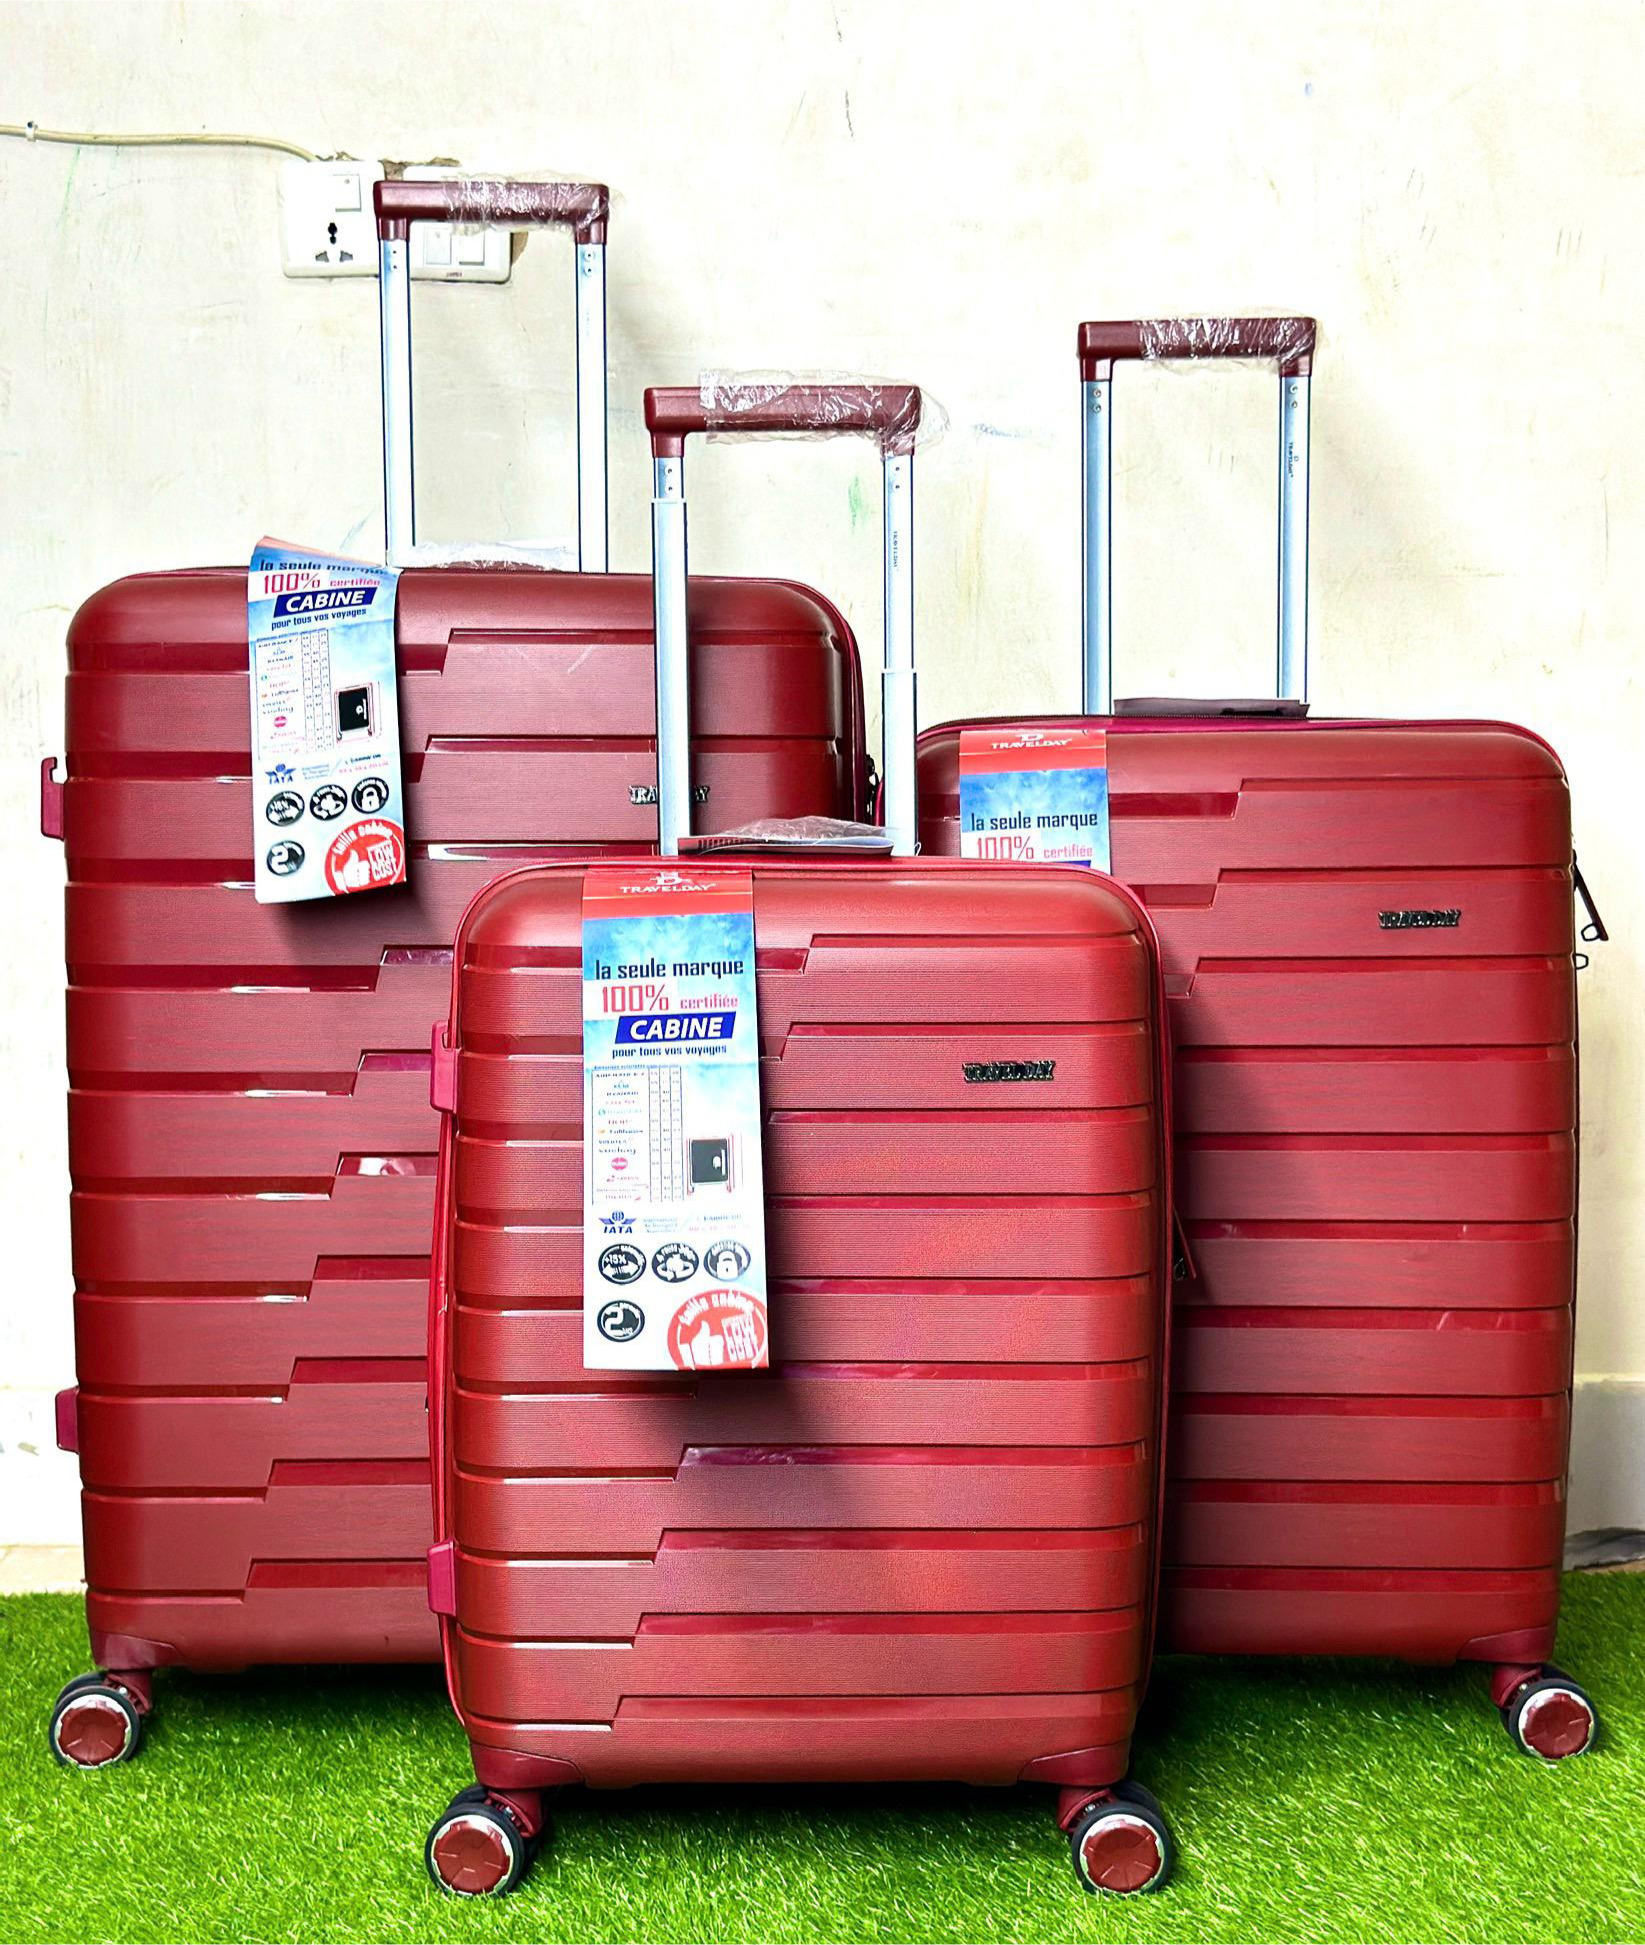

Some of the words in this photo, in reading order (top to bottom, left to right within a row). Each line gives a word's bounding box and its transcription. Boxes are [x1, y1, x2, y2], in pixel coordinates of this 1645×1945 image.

[260, 559, 273, 571] la
[279, 561, 321, 570] seule
[263, 573, 320, 594] 100%
[286, 591, 365, 613] CABINE
[271, 619, 291, 631] pour
[293, 615, 311, 626] tous
[314, 613, 328, 621] vos
[332, 608, 366, 619] voyages
[991, 738, 1072, 749] TRAVELDAY
[269, 775, 293, 784] IATA
[971, 812, 984, 831] la
[990, 811, 1031, 830] seule
[1037, 813, 1097, 830] marque
[977, 835, 1034, 860] 100%
[1043, 843, 1093, 859] certifiée
[620, 882, 716, 893] TRAVELDAY
[596, 959, 611, 980] la
[618, 957, 666, 978] seule
[673, 960, 743, 979] marque
[602, 984, 669, 1013] 100%
[680, 993, 738, 1009] certifiée
[630, 1016, 723, 1040] CABINE
[612, 1048, 636, 1059] pour
[640, 1046, 661, 1056] tous
[665, 1047, 682, 1055] vos
[685, 1045, 727, 1057] voyages
[604, 1226, 633, 1234] IATA
